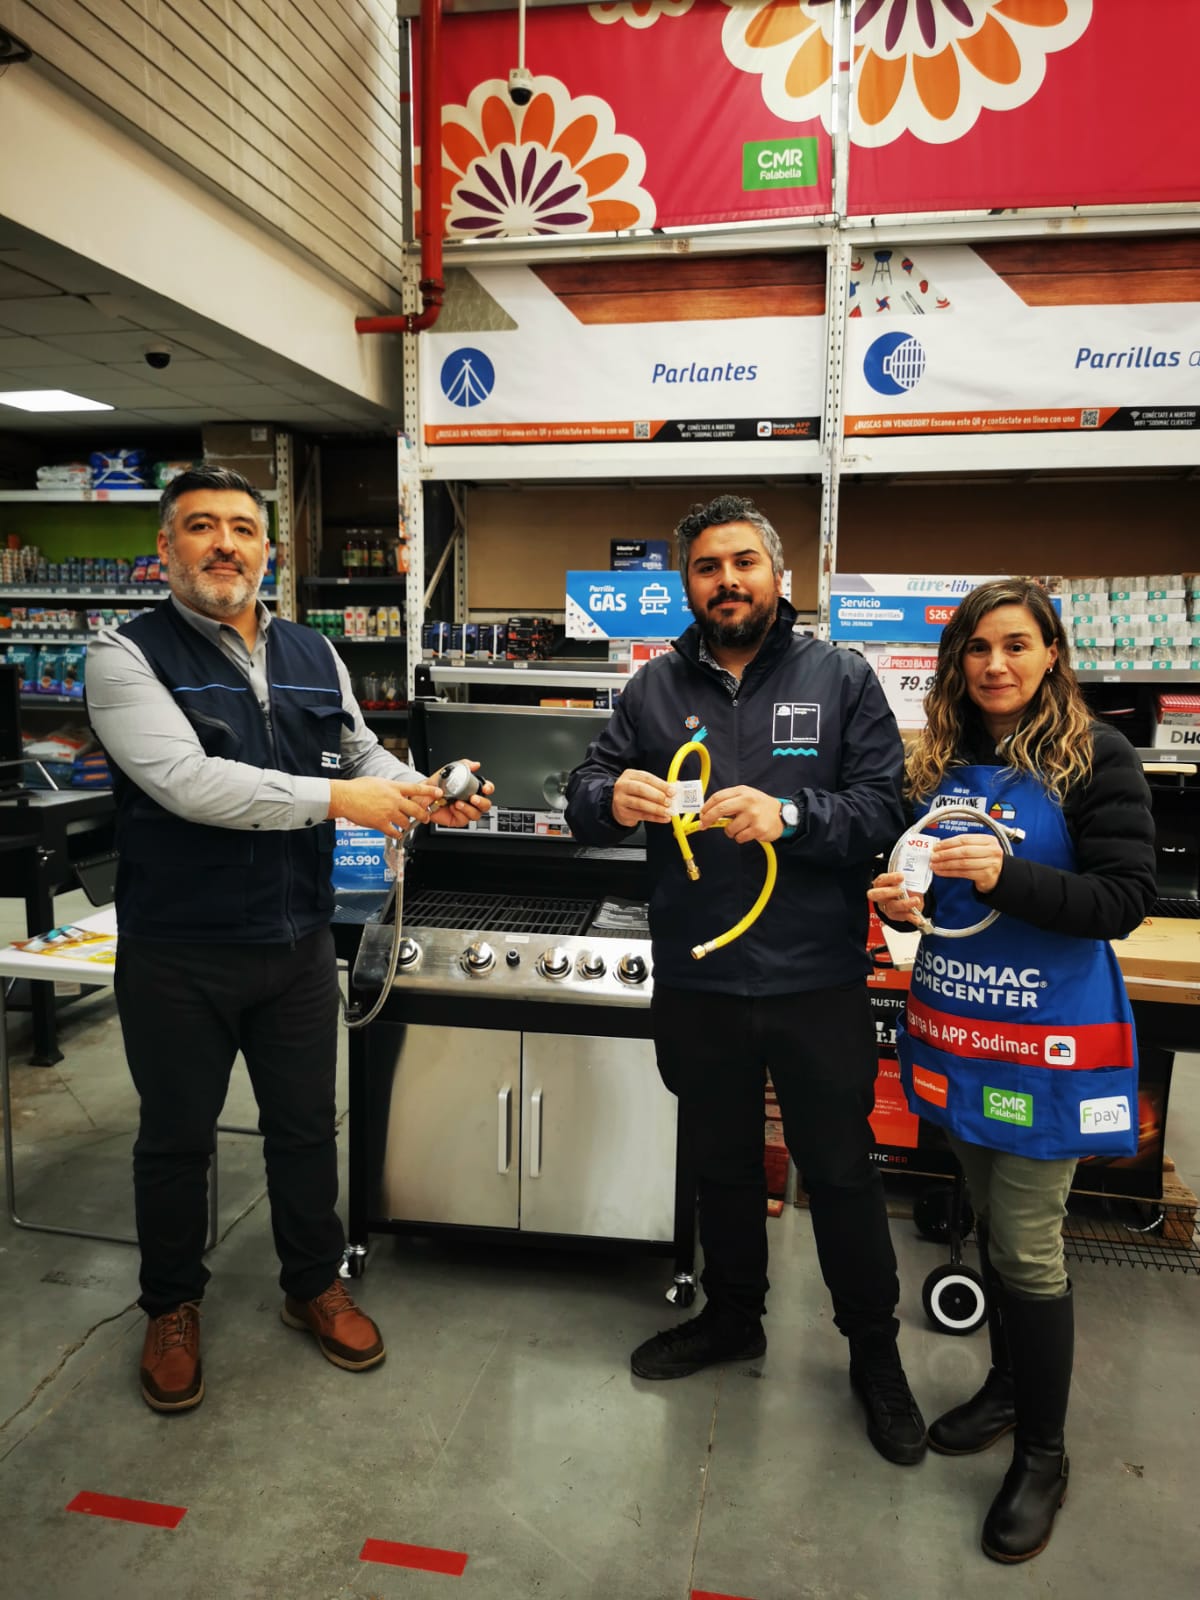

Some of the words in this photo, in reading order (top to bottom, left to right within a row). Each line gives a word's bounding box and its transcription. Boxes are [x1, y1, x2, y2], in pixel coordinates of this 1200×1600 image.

[757, 149, 803, 168] CMR
[760, 168, 802, 180] Falabella
[1075, 346, 1181, 369] Parrillas
[652, 362, 758, 384] Parlantes
[854, 420, 882, 430] ¿BUSCAS
[893, 418, 930, 428] VENDEDOR?
[931, 418, 956, 427] Escanea
[956, 418, 970, 426] este
[972, 417, 980, 426] QR
[988, 416, 1022, 424] contáctate
[951, 580, 978, 592] libr
[589, 593, 627, 612] GAS
[840, 597, 880, 608] Servicio
[929, 610, 955, 620] $26.9
[900, 676, 936, 691] 79.9
[335, 855, 380, 866] $26.990
[915, 967, 1038, 1008] OMECENTER
[929, 1020, 939, 1038] la
[942, 1024, 968, 1046] APP
[972, 1030, 1039, 1055] Sodimac
[989, 1092, 1026, 1114] CMR
[990, 1108, 1027, 1122] Falabella
[1083, 1106, 1120, 1126] Fpay
